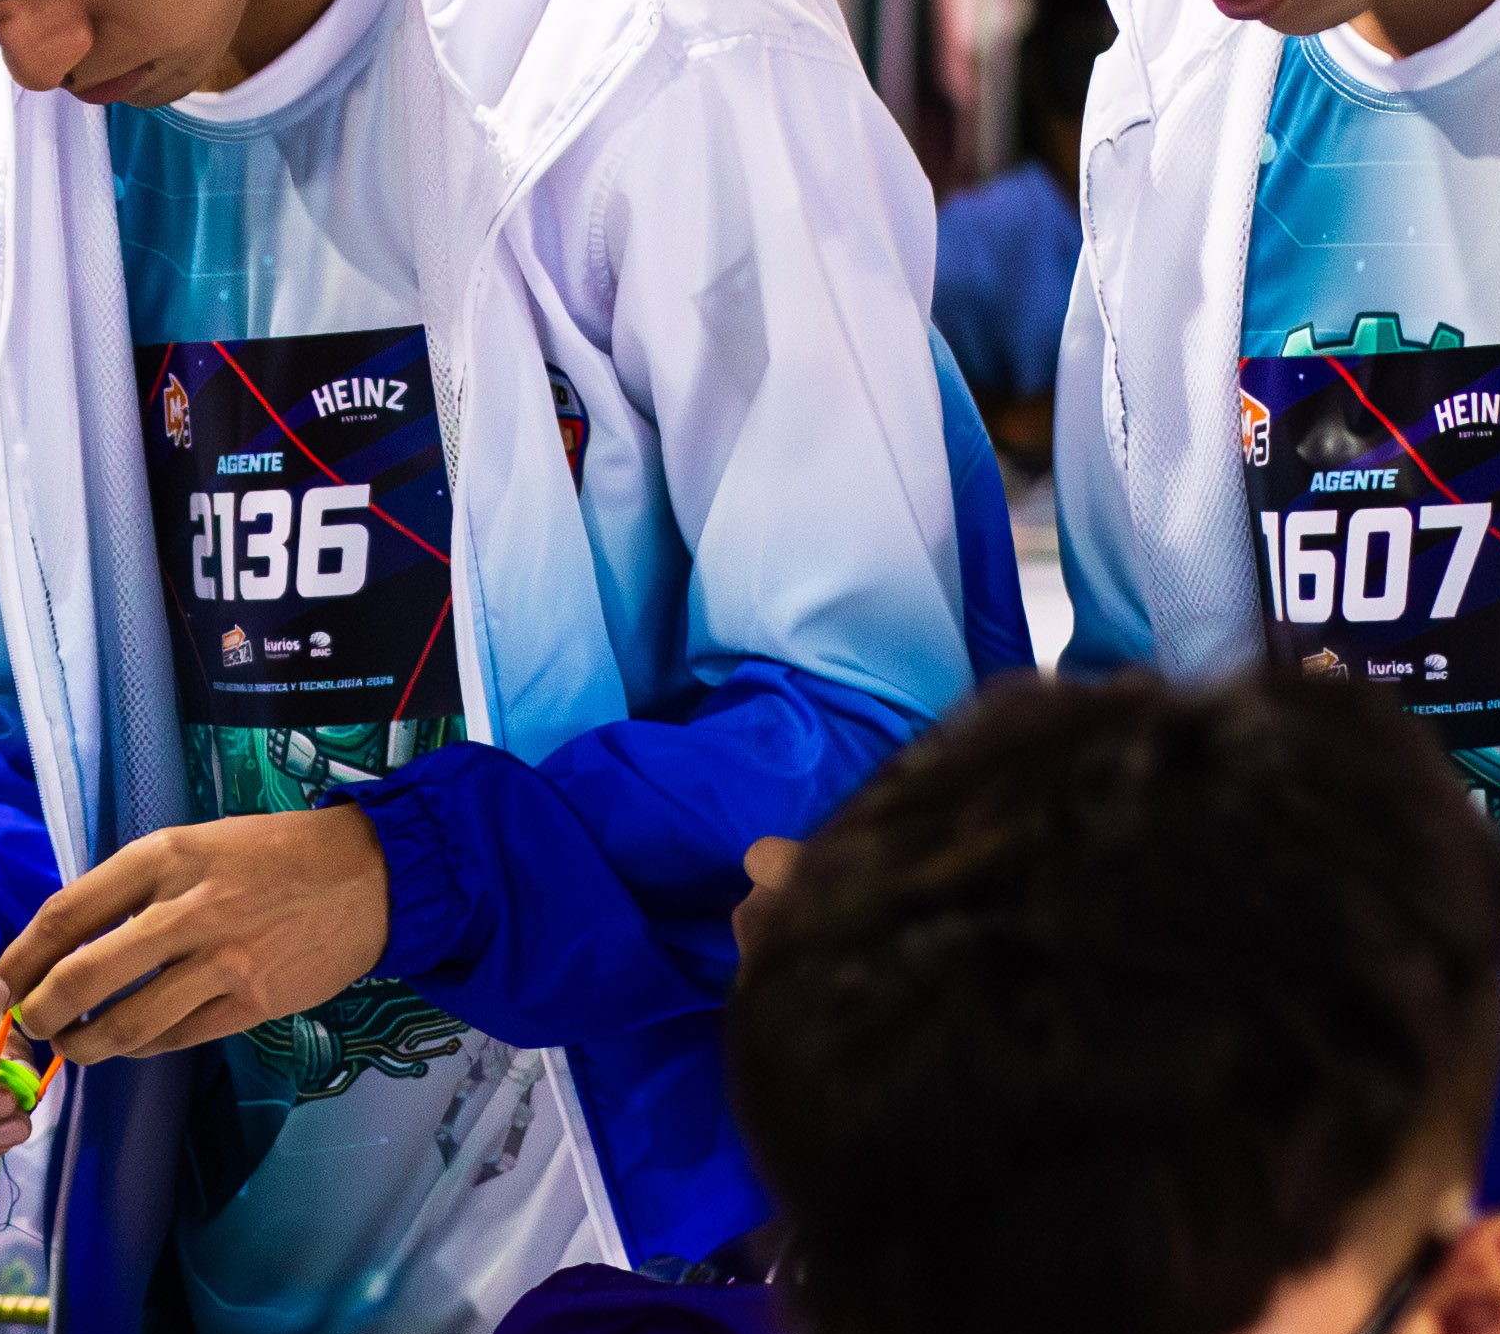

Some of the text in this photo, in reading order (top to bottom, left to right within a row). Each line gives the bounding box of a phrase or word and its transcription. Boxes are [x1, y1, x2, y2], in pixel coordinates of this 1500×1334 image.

[311, 377, 408, 418] HEINZ
[216, 452, 284, 475] AGENTE
[1310, 468, 1399, 492] AGENTE
[189, 483, 371, 601] 2136
[1260, 502, 1492, 624] 1607
[264, 637, 300, 652] kurios
[1367, 660, 1413, 676] kurios
